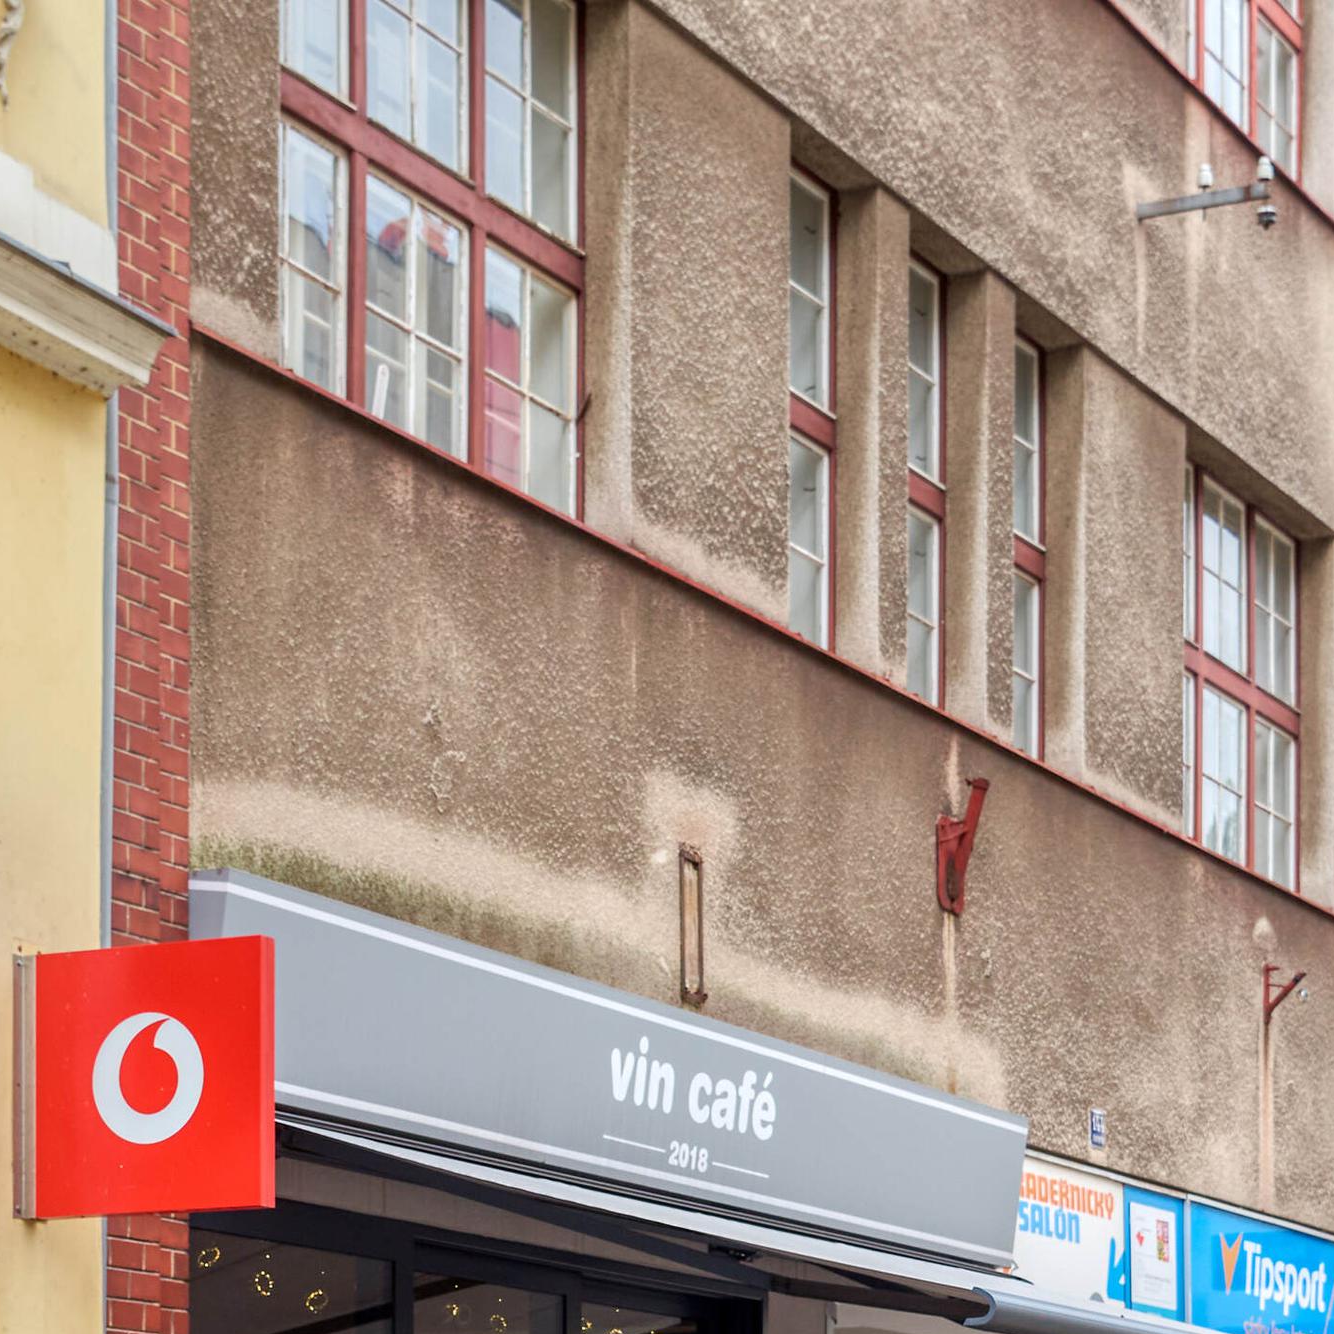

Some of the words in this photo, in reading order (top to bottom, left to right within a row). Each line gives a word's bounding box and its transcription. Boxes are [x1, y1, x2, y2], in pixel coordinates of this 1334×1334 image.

[610, 1036, 675, 1115] vin
[688, 1070, 777, 1141] café
[668, 1140, 709, 1173] 2018
[1243, 1240, 1327, 1317] Tipsport
